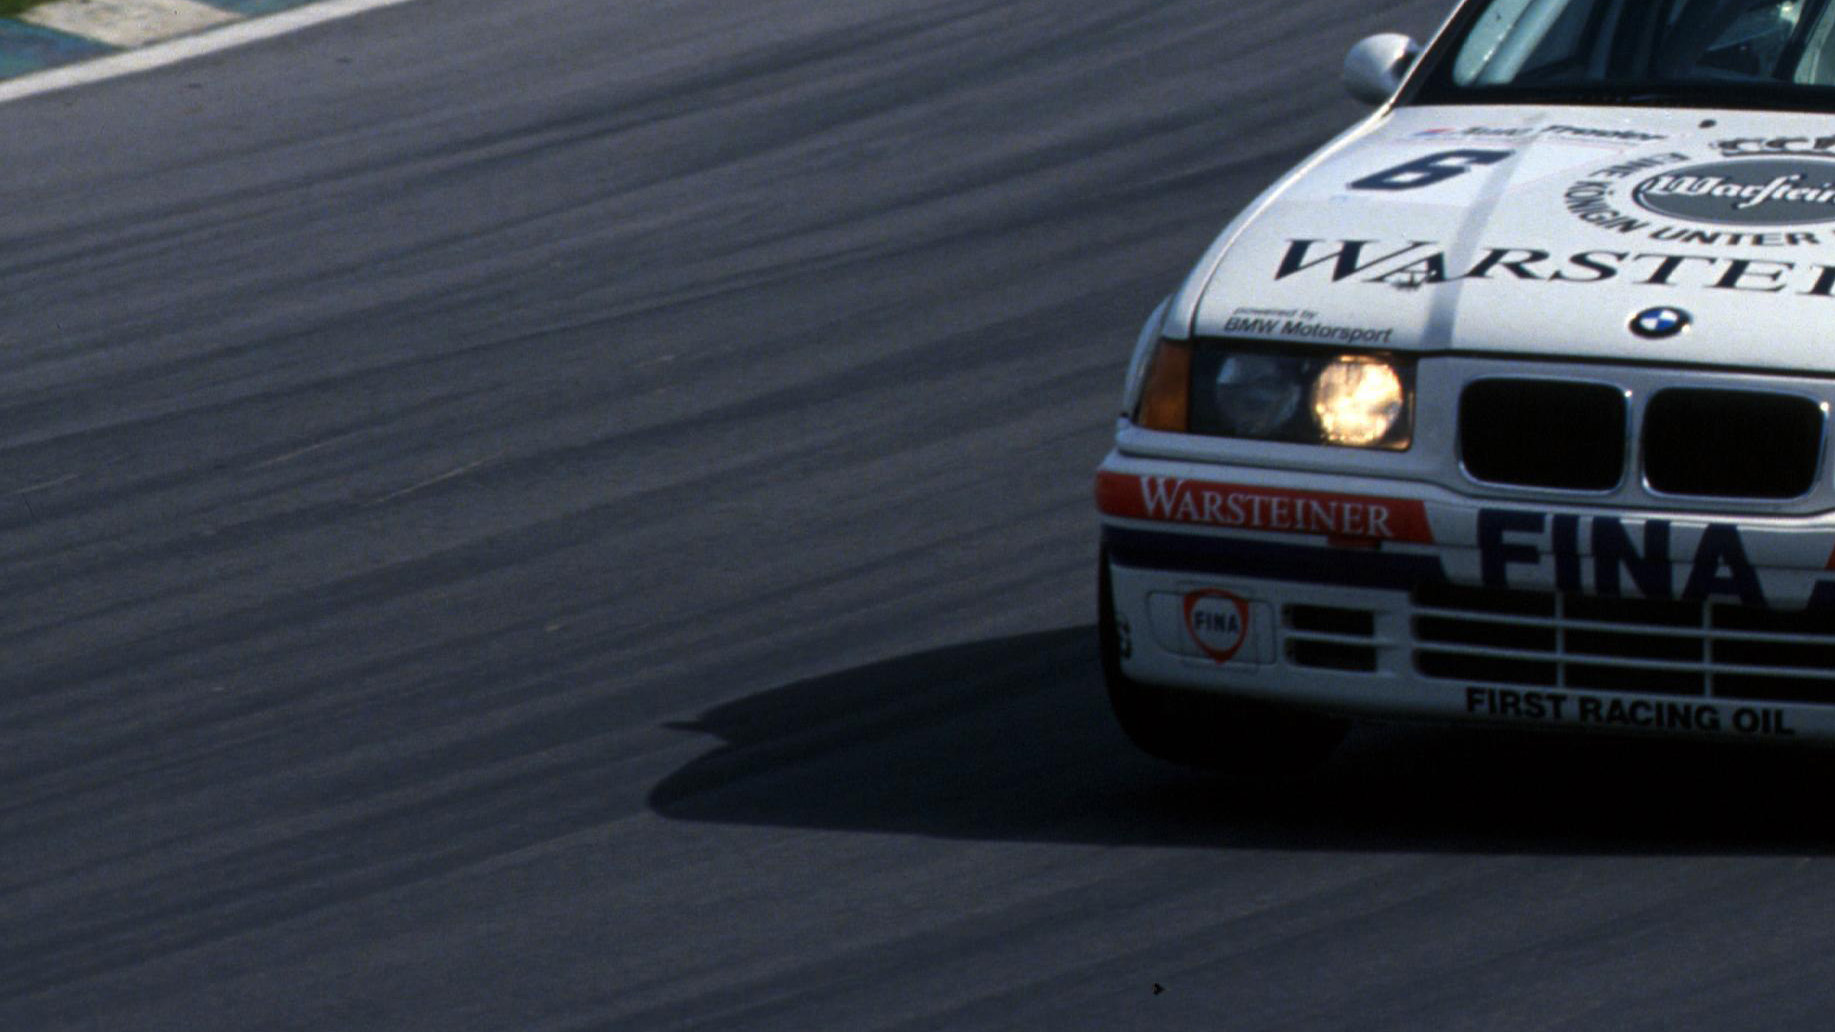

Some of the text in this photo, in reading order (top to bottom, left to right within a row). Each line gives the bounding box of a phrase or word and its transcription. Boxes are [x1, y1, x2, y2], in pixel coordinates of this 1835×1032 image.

[1346, 149, 1516, 191] 6
[1649, 226, 1821, 247] UNTER
[1224, 316, 1394, 344] BMW Motorsport
[1138, 476, 1395, 538] WARSTEINER
[1477, 507, 1767, 609] FINA
[1194, 610, 1238, 634] FINA
[1466, 685, 1796, 736] FIRST RACING OIL
